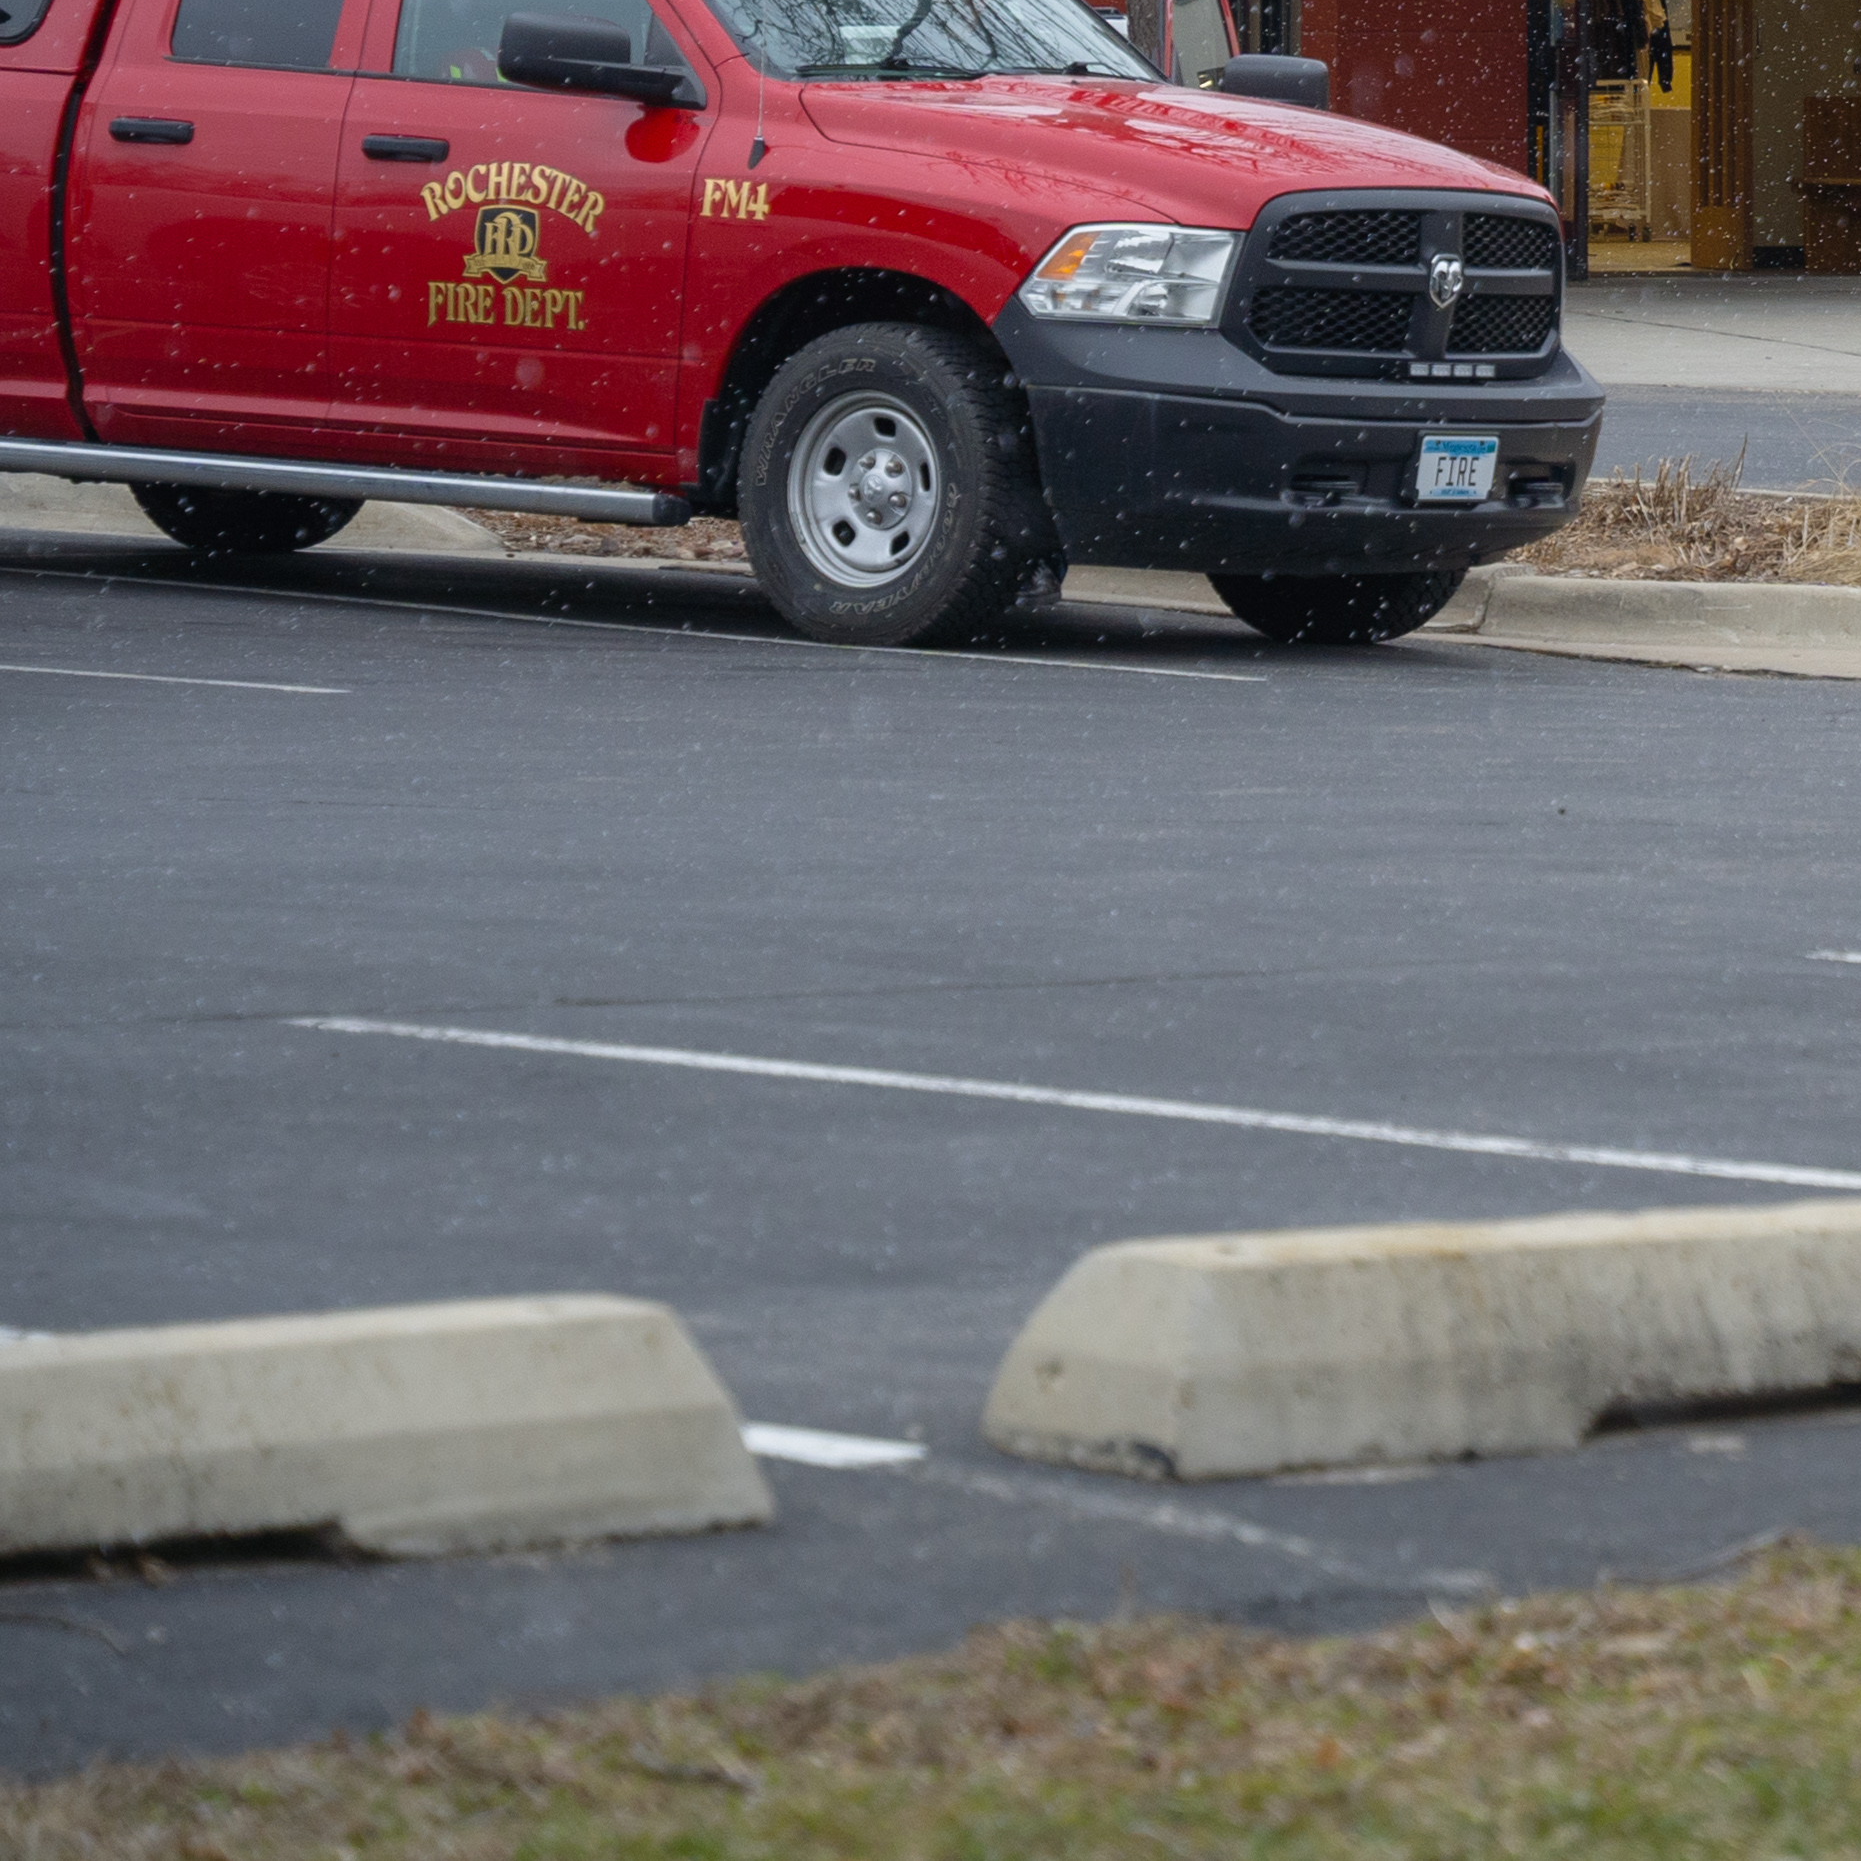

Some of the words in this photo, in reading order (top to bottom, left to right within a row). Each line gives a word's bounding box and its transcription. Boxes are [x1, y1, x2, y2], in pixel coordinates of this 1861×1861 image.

[419, 160, 606, 234] ROCHESTER
[700, 177, 771, 221] FM4
[427, 281, 495, 327] FIRE
[502, 286, 586, 330] DEPT.
[755, 357, 877, 487] WRANGLER
[1435, 456, 1480, 486] FIRE
